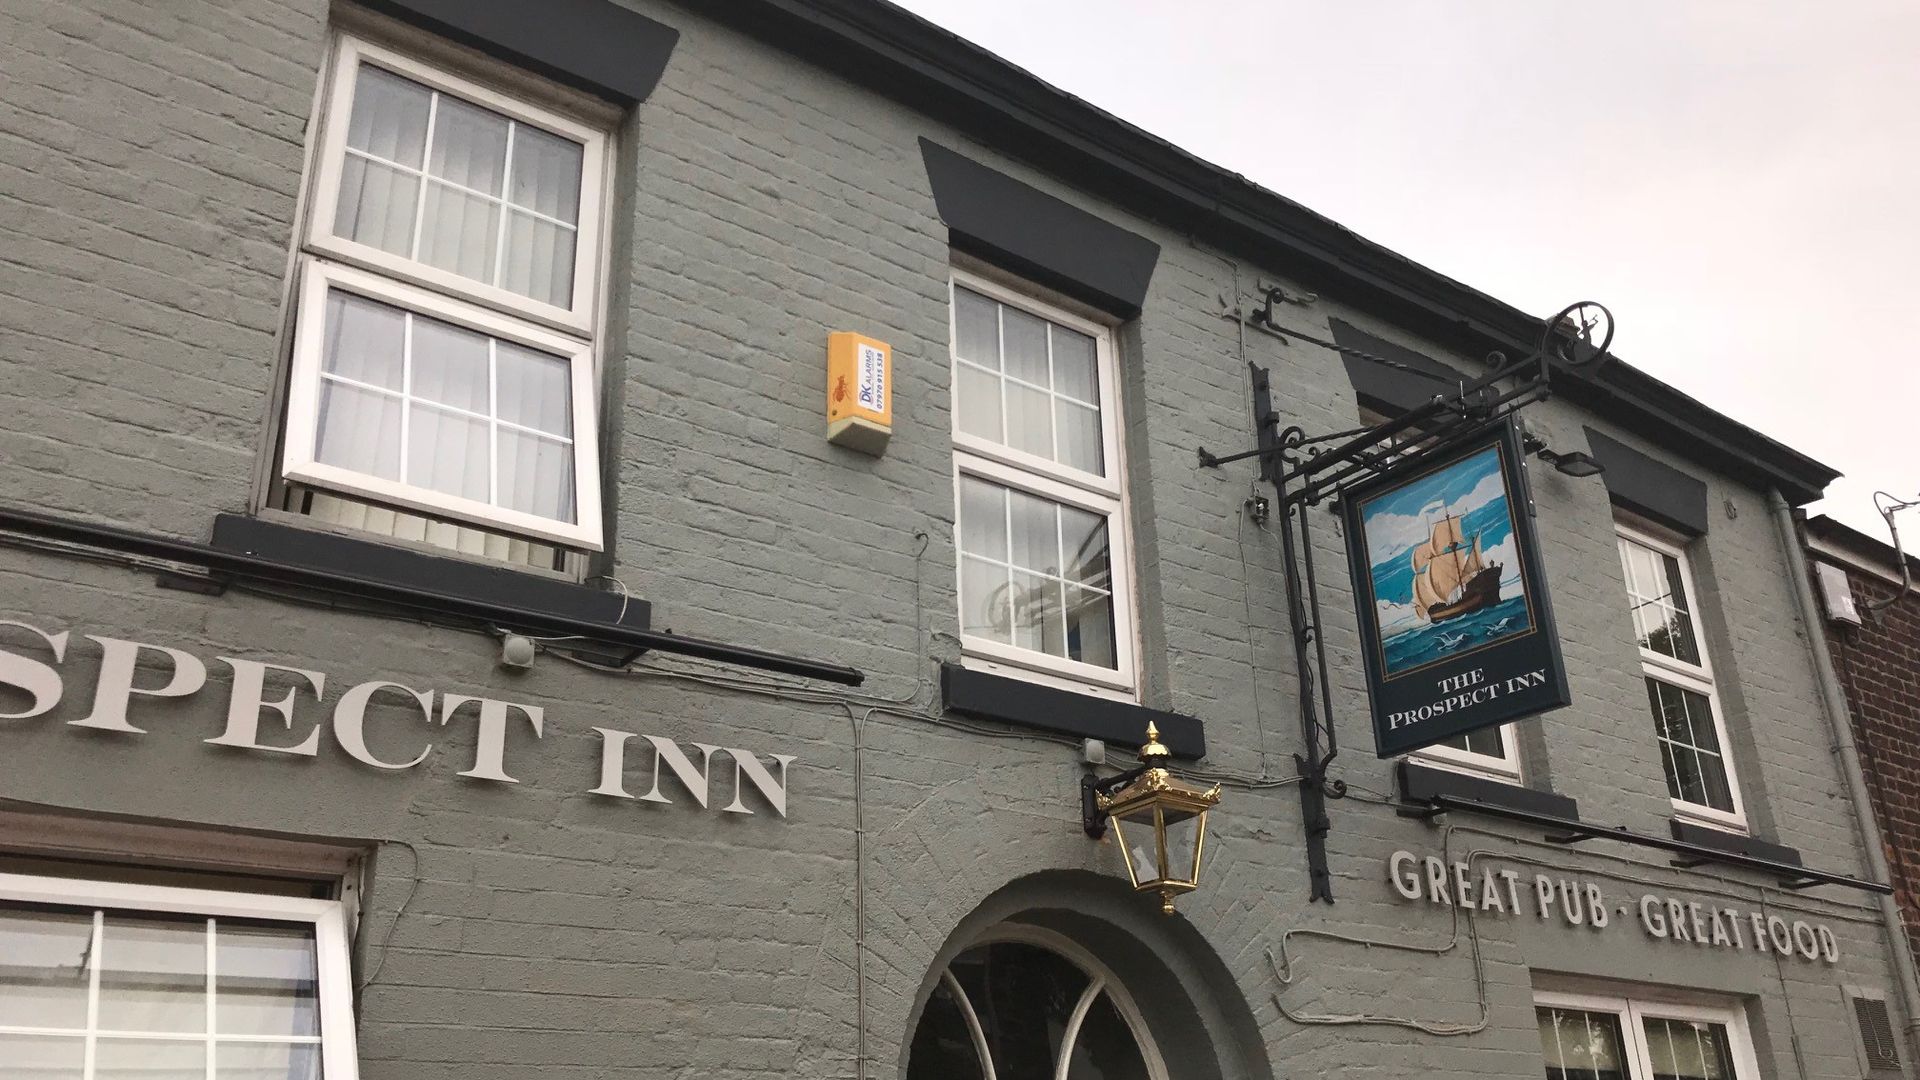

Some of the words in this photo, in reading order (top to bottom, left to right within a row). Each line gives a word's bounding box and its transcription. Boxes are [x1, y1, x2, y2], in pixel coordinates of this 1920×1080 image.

[861, 384, 871, 403] DK
[1387, 683, 1500, 730] PROSPECT
[1504, 668, 1547, 694] INN
[1437, 668, 1484, 694] THE
[587, 726, 798, 818] INN
[1389, 850, 1521, 916] GREAT
[1535, 874, 1609, 928] PUB
[1639, 894, 1744, 949] GREAT
[1751, 911, 1839, 963] FOOD
